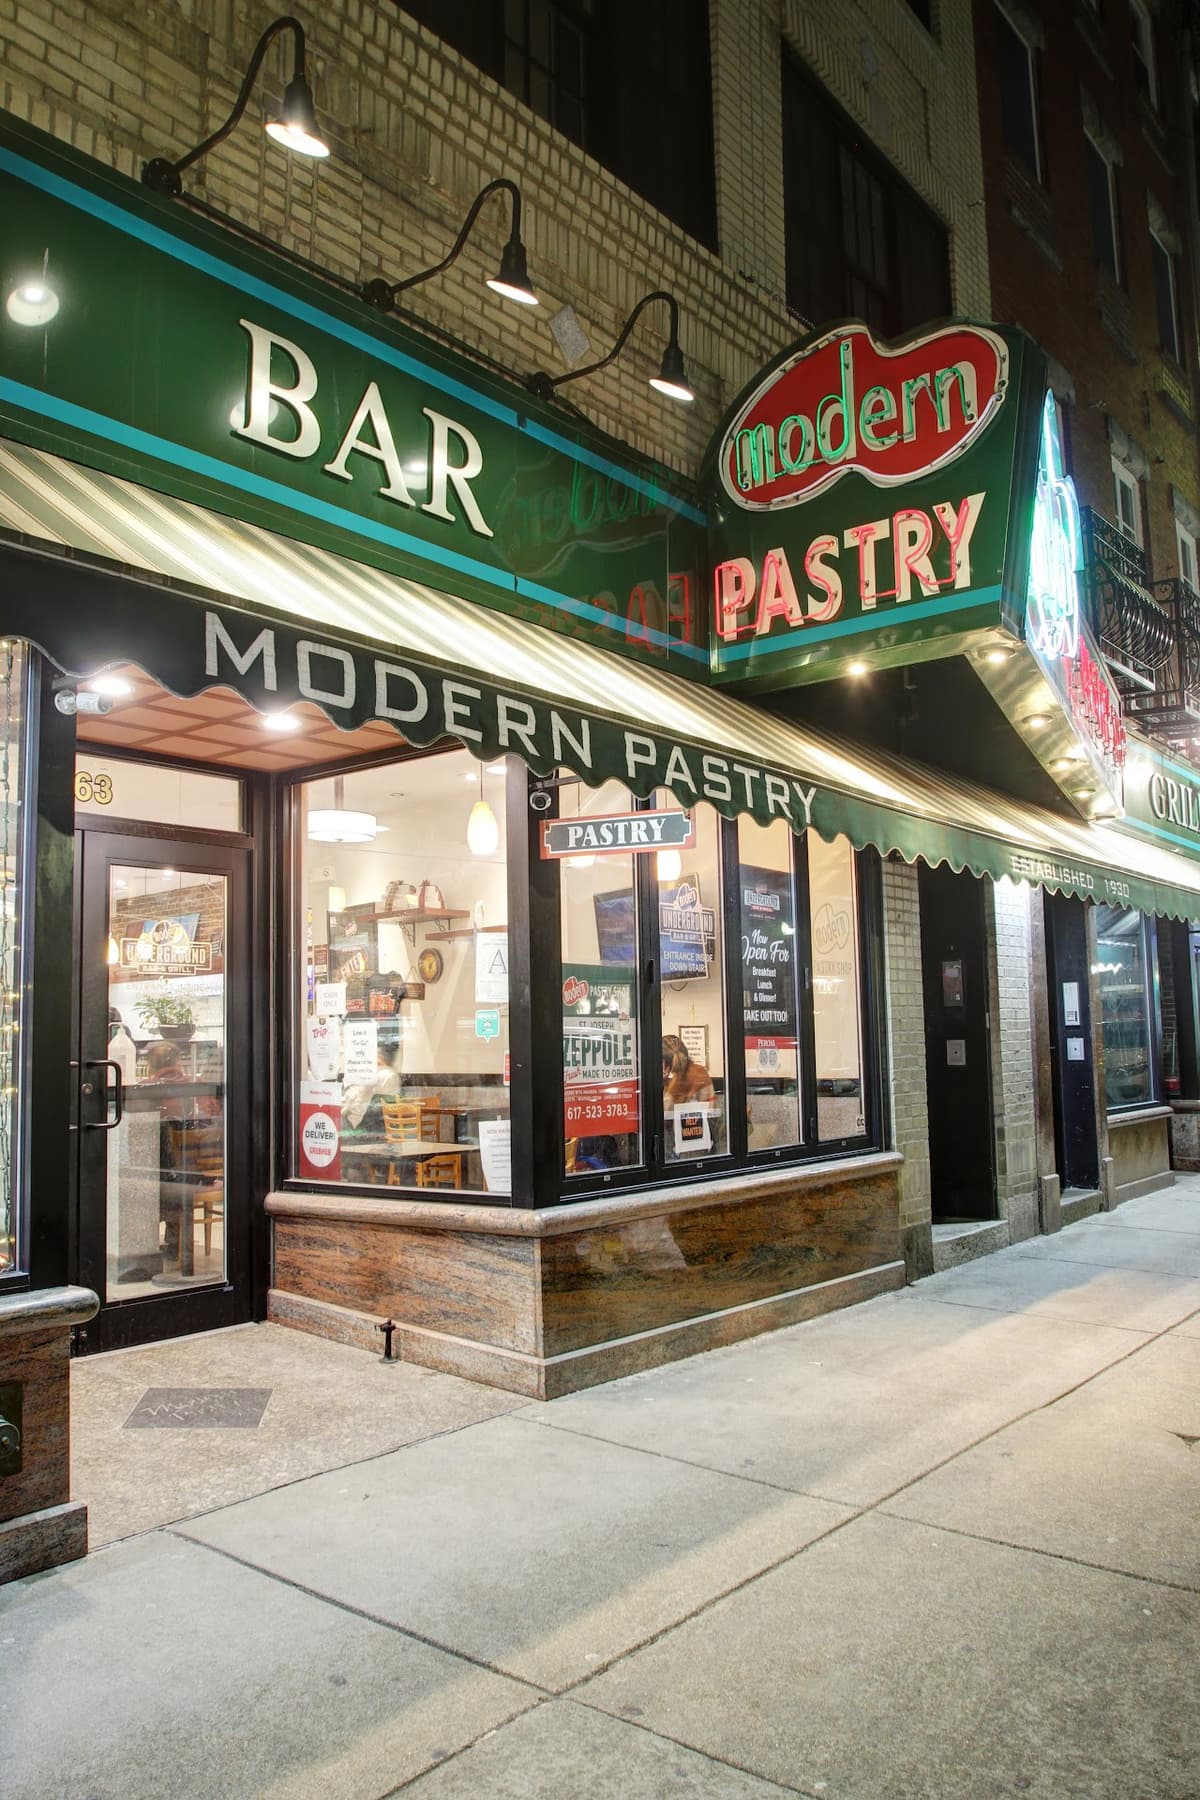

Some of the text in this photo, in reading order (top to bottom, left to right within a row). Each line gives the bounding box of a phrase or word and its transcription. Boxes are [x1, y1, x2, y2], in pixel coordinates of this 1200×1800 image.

[735, 338, 977, 491] modern
[230, 318, 493, 538] BAR
[714, 492, 985, 641] PASTRY
[205, 611, 592, 768] MODERN
[624, 731, 817, 823] PASTRY
[75, 771, 113, 805] 63
[1149, 772, 1200, 833] GRIL
[567, 818, 667, 848] PASTRY
[1011, 856, 1130, 898] ESTABLISHED 1930
[752, 929, 769, 945] Now
[127, 943, 206, 964] UERGROUND
[663, 950, 695, 961] ENTRANCE
[770, 940, 790, 963] For
[669, 962, 687, 971] DOWN
[752, 966, 776, 978] Breakfast
[590, 985, 612, 998] PASTRY
[757, 980, 772, 989] Lunch
[753, 992, 777, 1003] & Dinner!
[744, 1010, 788, 1023] TAKE OUT TOO!
[564, 1034, 633, 1067] ZEPPOLE
[583, 1069, 600, 1079] MADE
[602, 1069, 611, 1078] TO
[612, 1069, 634, 1078] ORDER
[567, 1104, 629, 1120] 617-523-3783
[315, 1121, 326, 1131] WE
